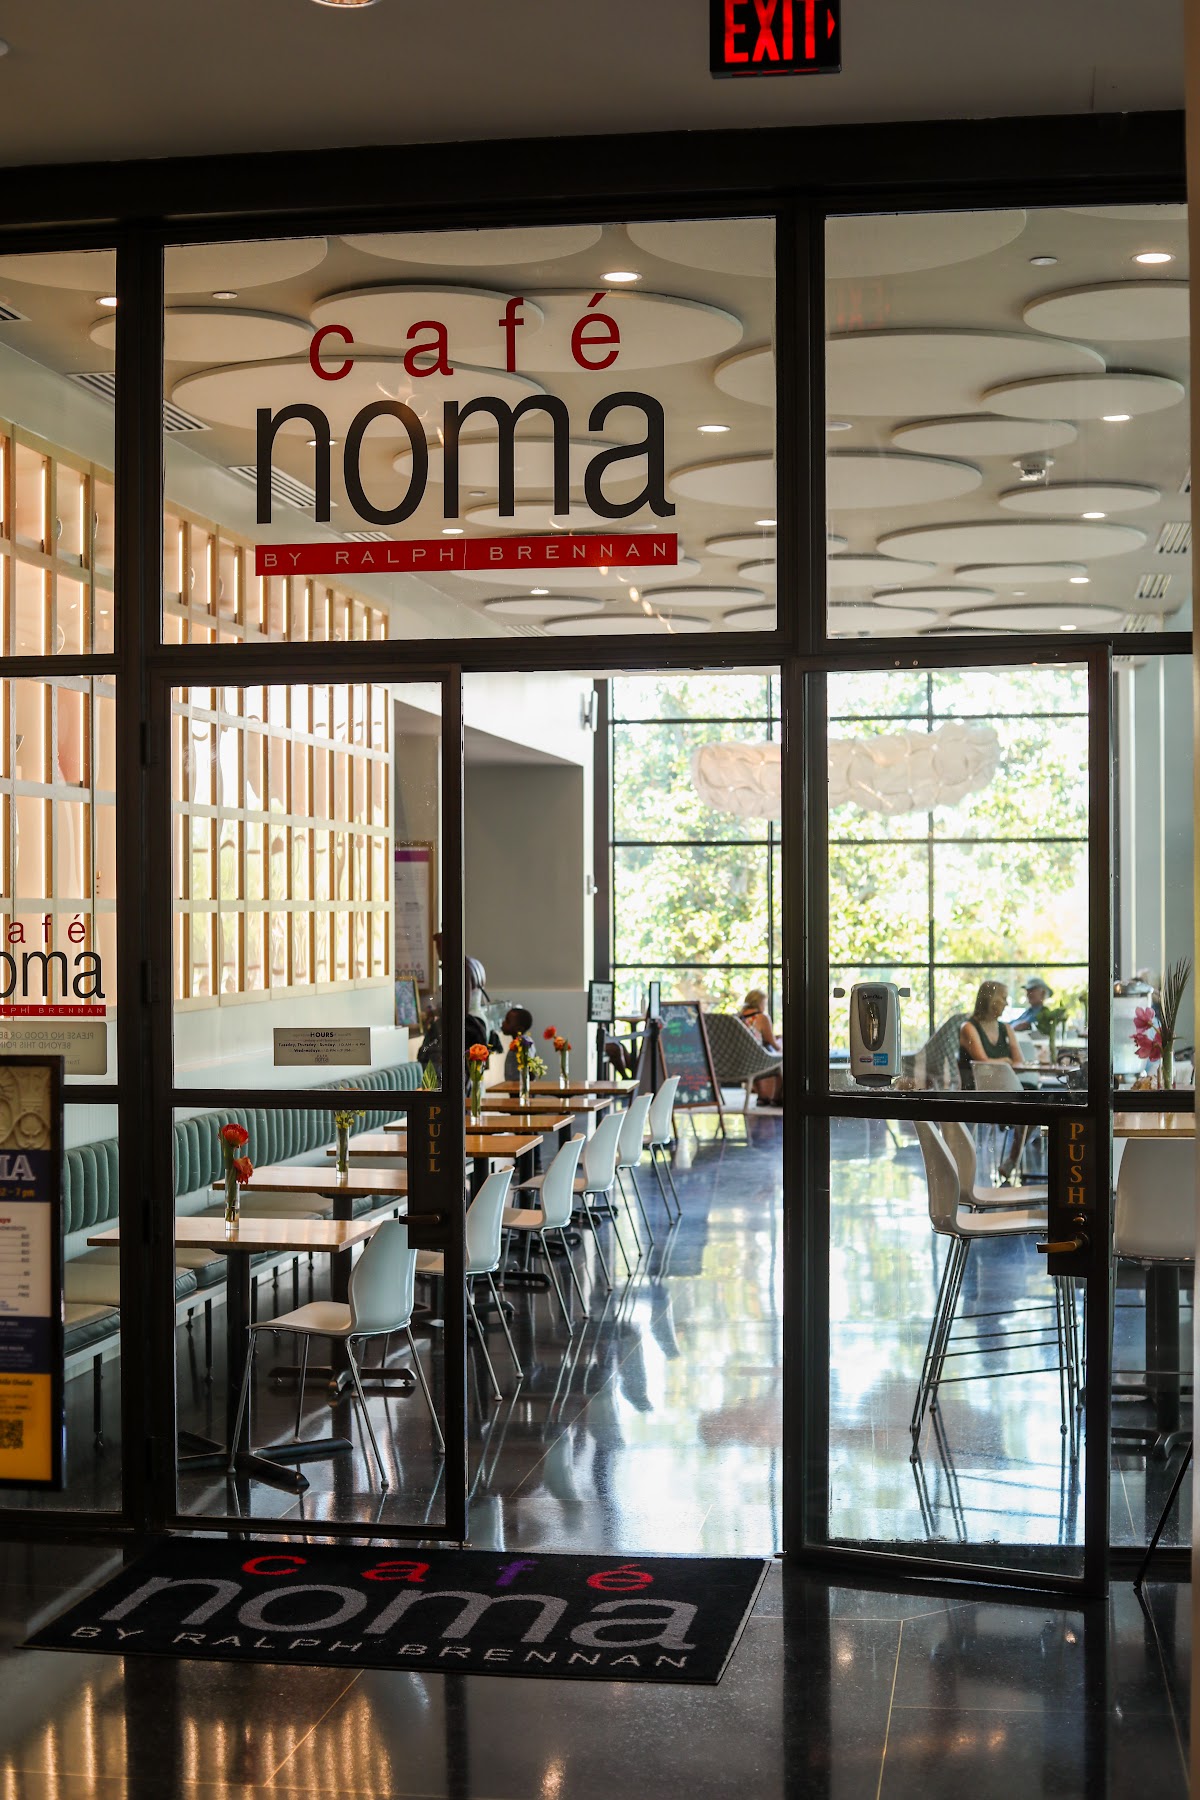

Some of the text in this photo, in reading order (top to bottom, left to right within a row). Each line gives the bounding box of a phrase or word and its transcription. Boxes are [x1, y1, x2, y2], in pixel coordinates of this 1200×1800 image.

[724, 0, 819, 63] EXIT
[309, 292, 621, 381] café
[256, 391, 676, 526] noma
[264, 542, 667, 567] BY RALPH BRENNAN
[7, 913, 86, 944] afé
[0, 951, 106, 999] oma
[428, 1106, 441, 1172] PULL
[1067, 1122, 1086, 1205] PUSH
[241, 1554, 654, 1592] café
[99, 1576, 698, 1651] noma
[71, 1626, 688, 1669] BY RALPH BRENNAN
